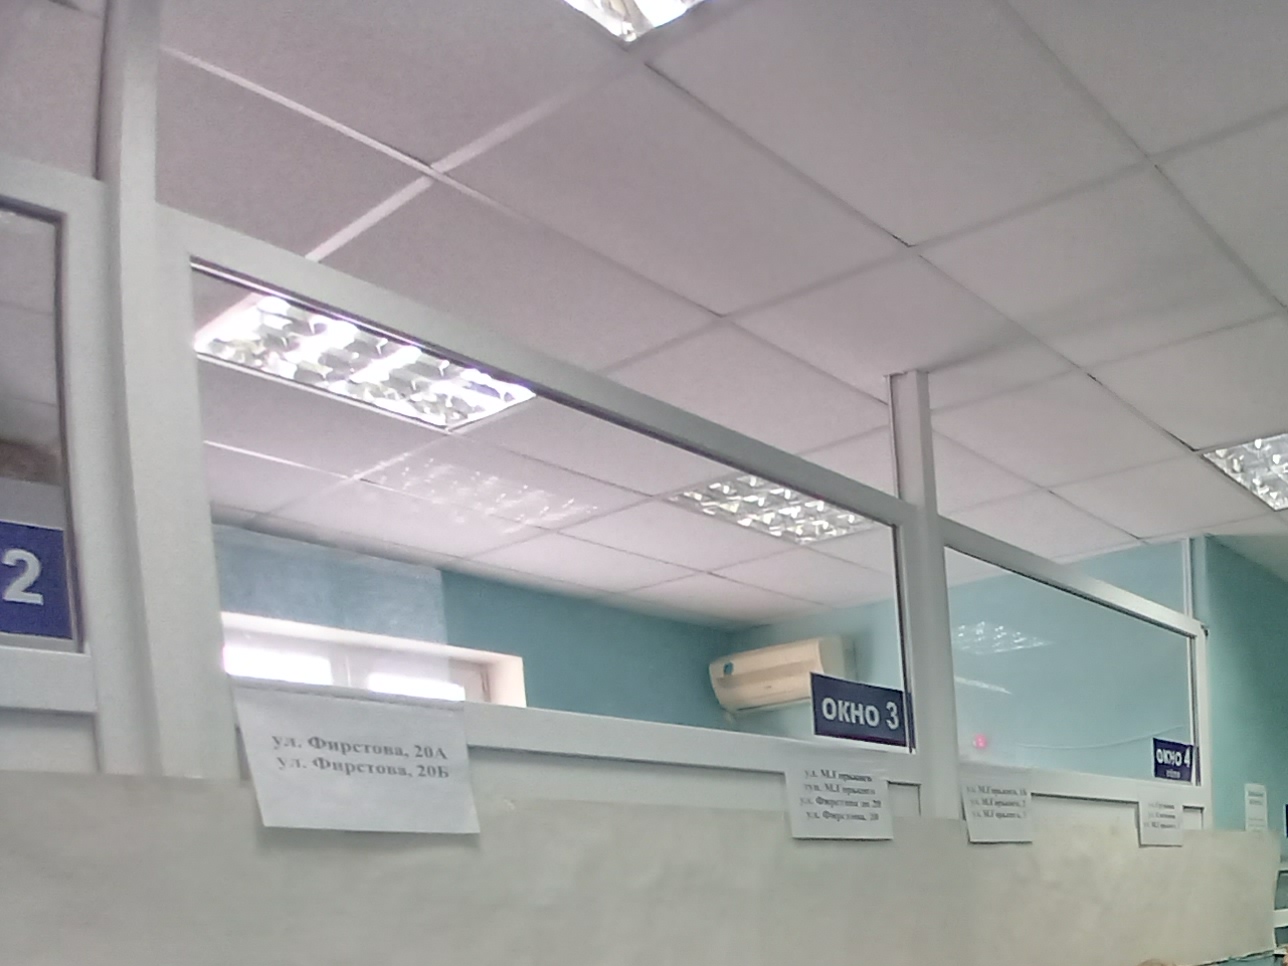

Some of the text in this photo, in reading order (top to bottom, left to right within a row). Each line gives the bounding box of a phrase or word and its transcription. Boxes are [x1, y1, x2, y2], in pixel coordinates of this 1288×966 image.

[2, 548, 44, 606] 2
[821, 697, 899, 730] ОКНО 3
[272, 735, 448, 760] ул. Фирстова, 20А
[1155, 746, 1190, 768] ОКНО 4
[276, 756, 450, 779] ул. Фирстова, 20Б
